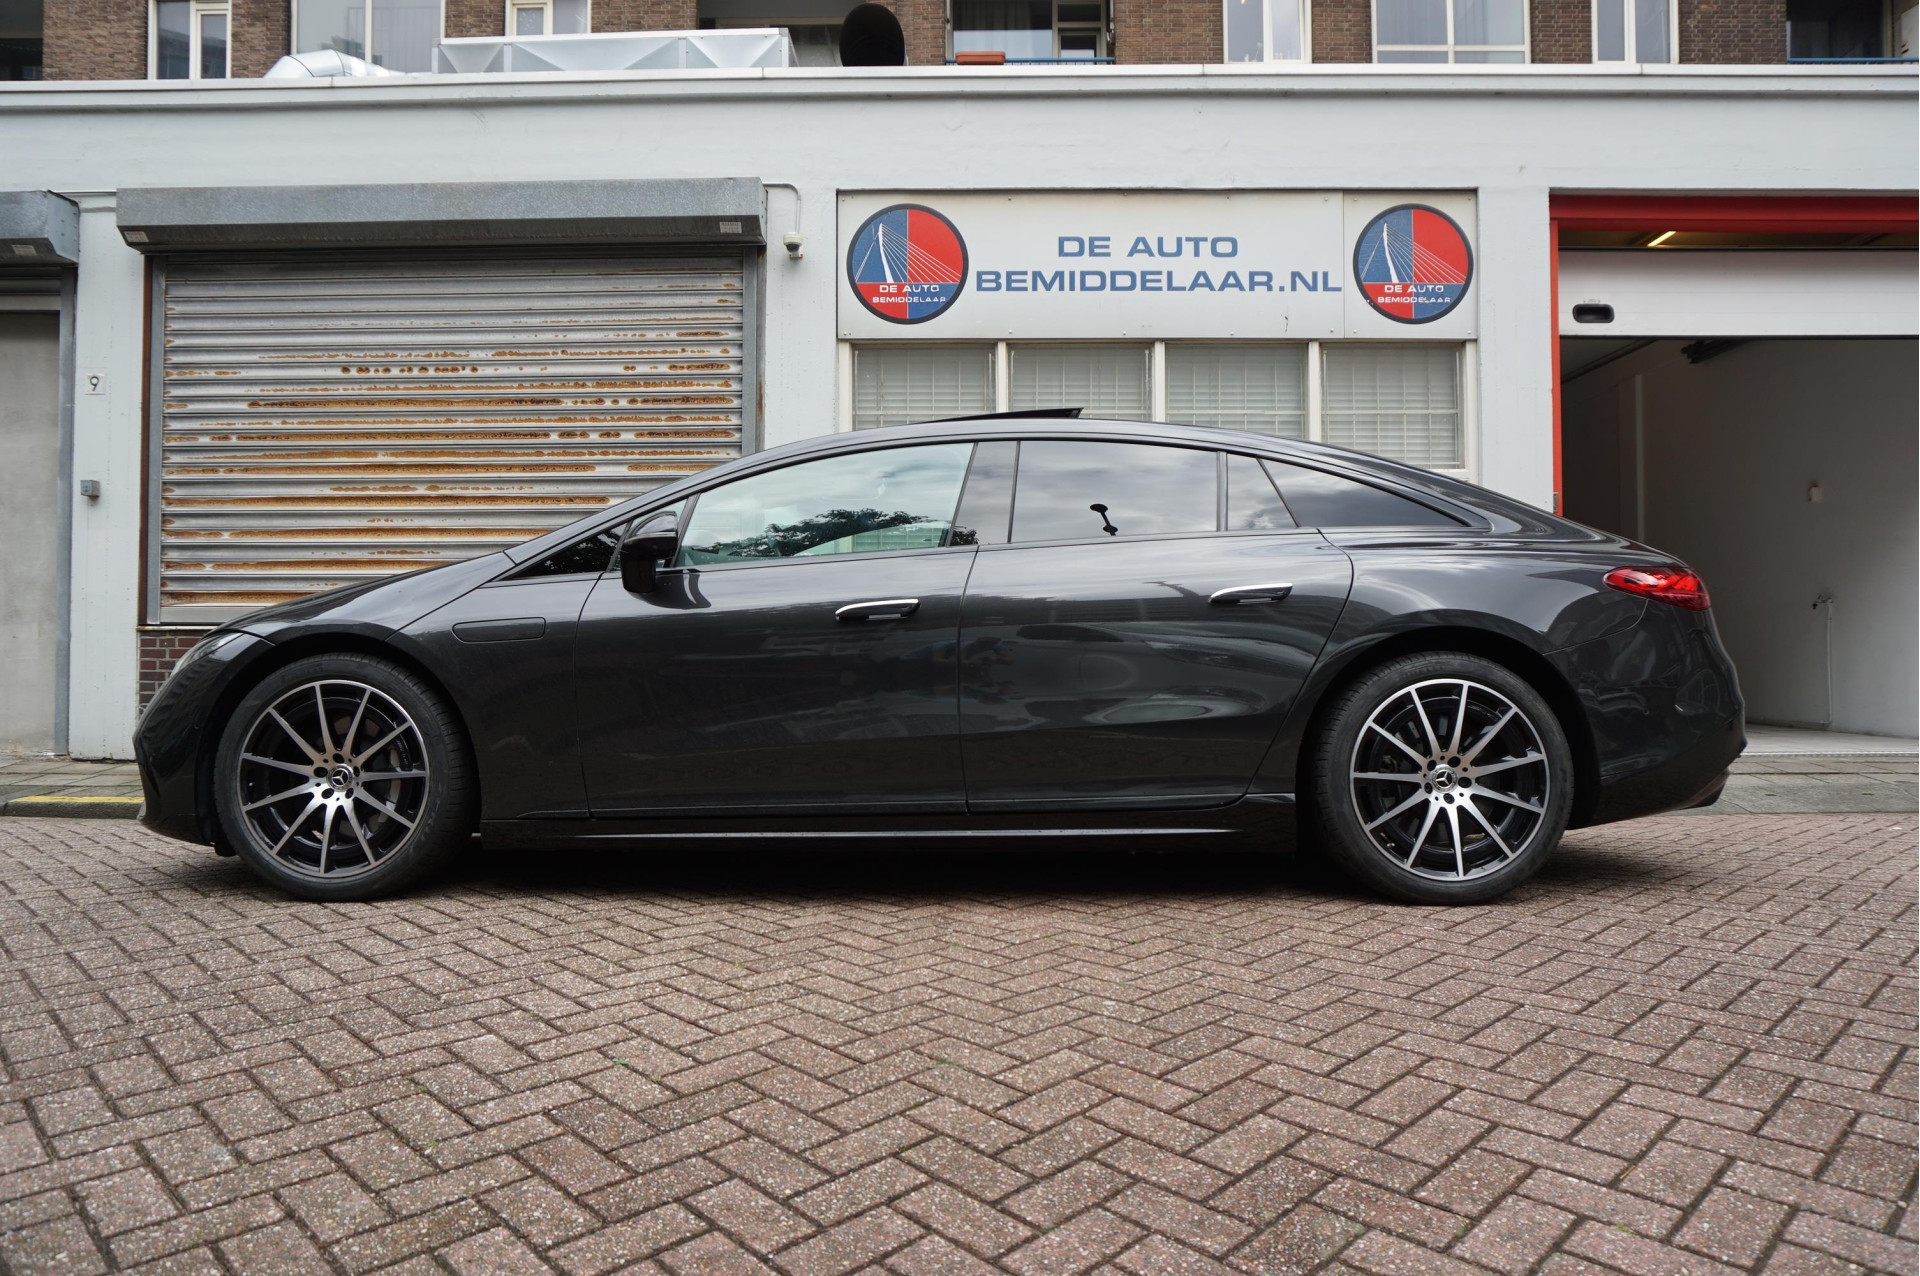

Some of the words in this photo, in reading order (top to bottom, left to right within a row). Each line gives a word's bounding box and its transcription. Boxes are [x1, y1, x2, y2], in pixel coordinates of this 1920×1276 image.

[1058, 236, 1111, 257] DE
[1126, 236, 1238, 258] AUTO
[879, 285, 898, 293] DE
[902, 285, 940, 293] AUTO
[976, 270, 1342, 292] BEMIDDELAAR.NL
[1384, 285, 1403, 293] DE
[1407, 285, 1444, 293] AUTO
[89, 375, 100, 391] 9
